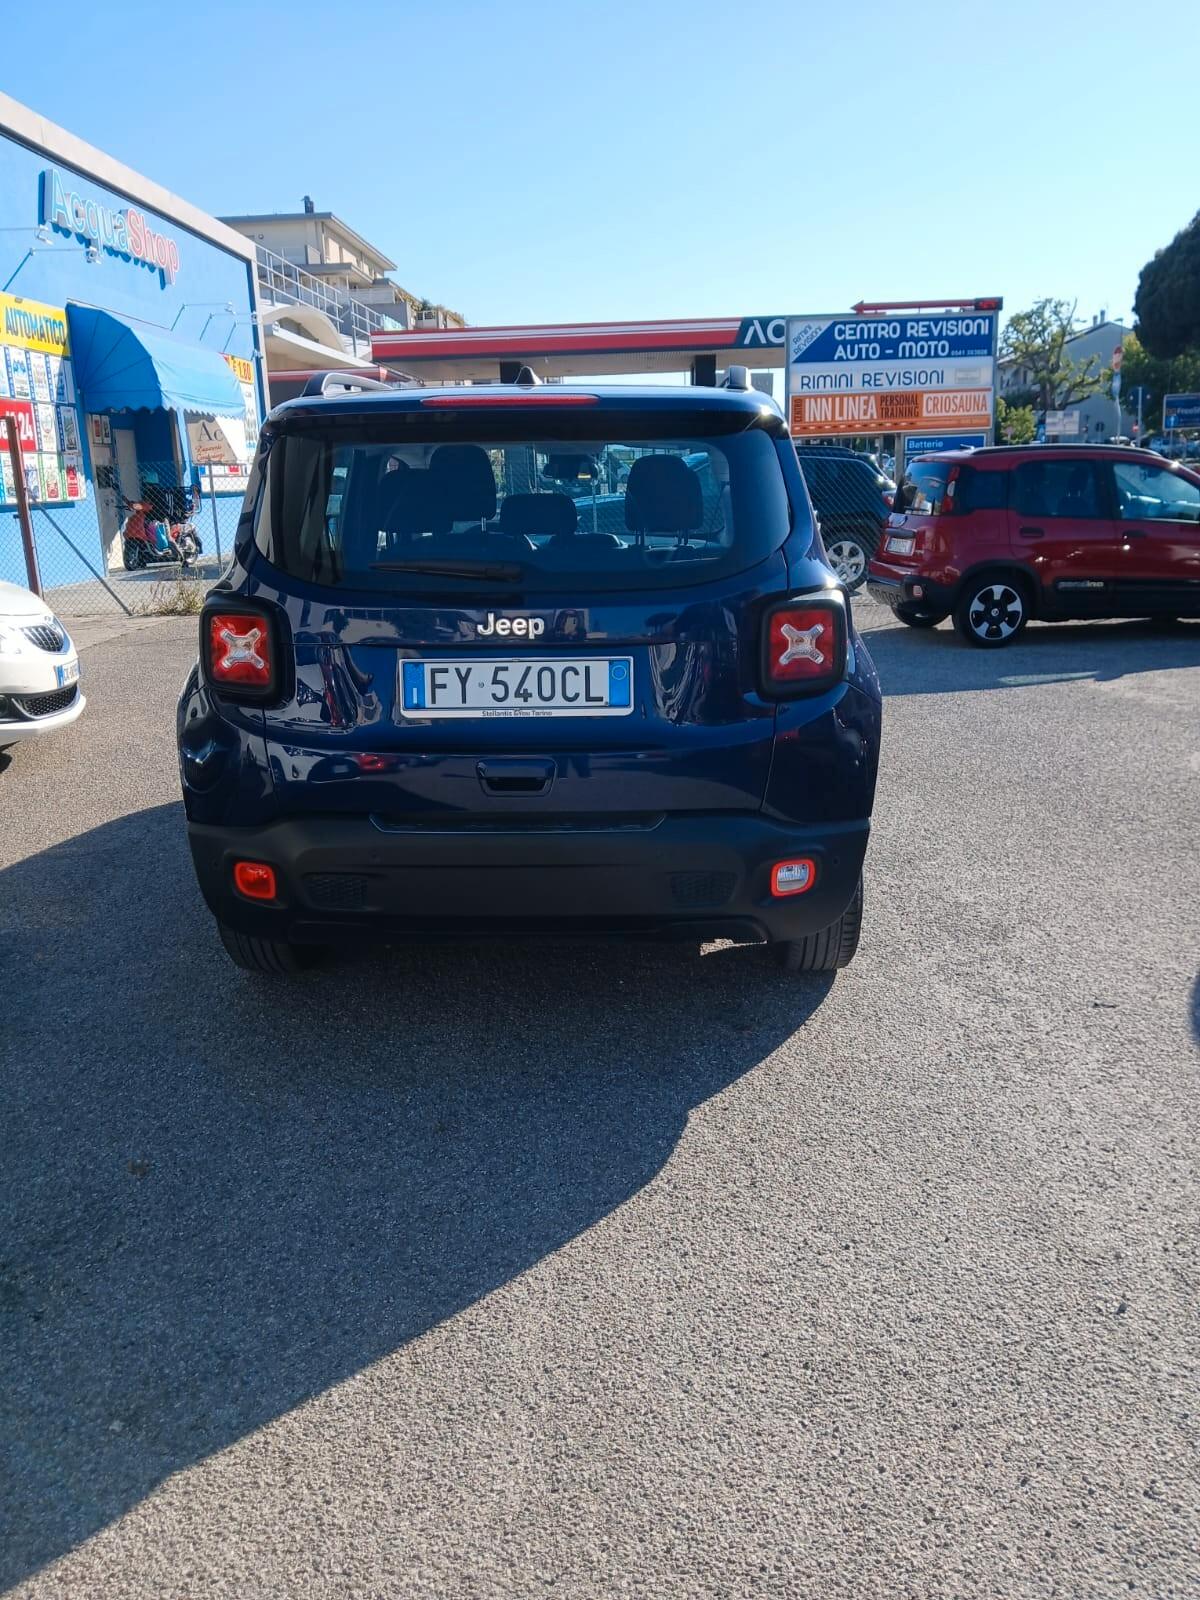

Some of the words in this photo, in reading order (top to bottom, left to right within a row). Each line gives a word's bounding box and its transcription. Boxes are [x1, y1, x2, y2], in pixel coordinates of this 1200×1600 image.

[50, 168, 180, 286] AcquaShop
[5, 306, 66, 346] AUTOMATICO
[834, 321, 901, 341] CENTRO
[906, 318, 989, 338] REVISIONI
[833, 344, 880, 361] AUTO
[898, 340, 950, 358] MOTO
[800, 373, 854, 391] RIMINI
[862, 369, 945, 388] REVISIONI
[879, 393, 919, 407] PERSONAL
[925, 393, 988, 415] CRIOSAUNA
[879, 405, 920, 418] TRAINING
[908, 439, 944, 449] Batterie
[477, 612, 545, 639] Jeep
[430, 667, 473, 705] FY
[490, 665, 605, 704] 540CL
